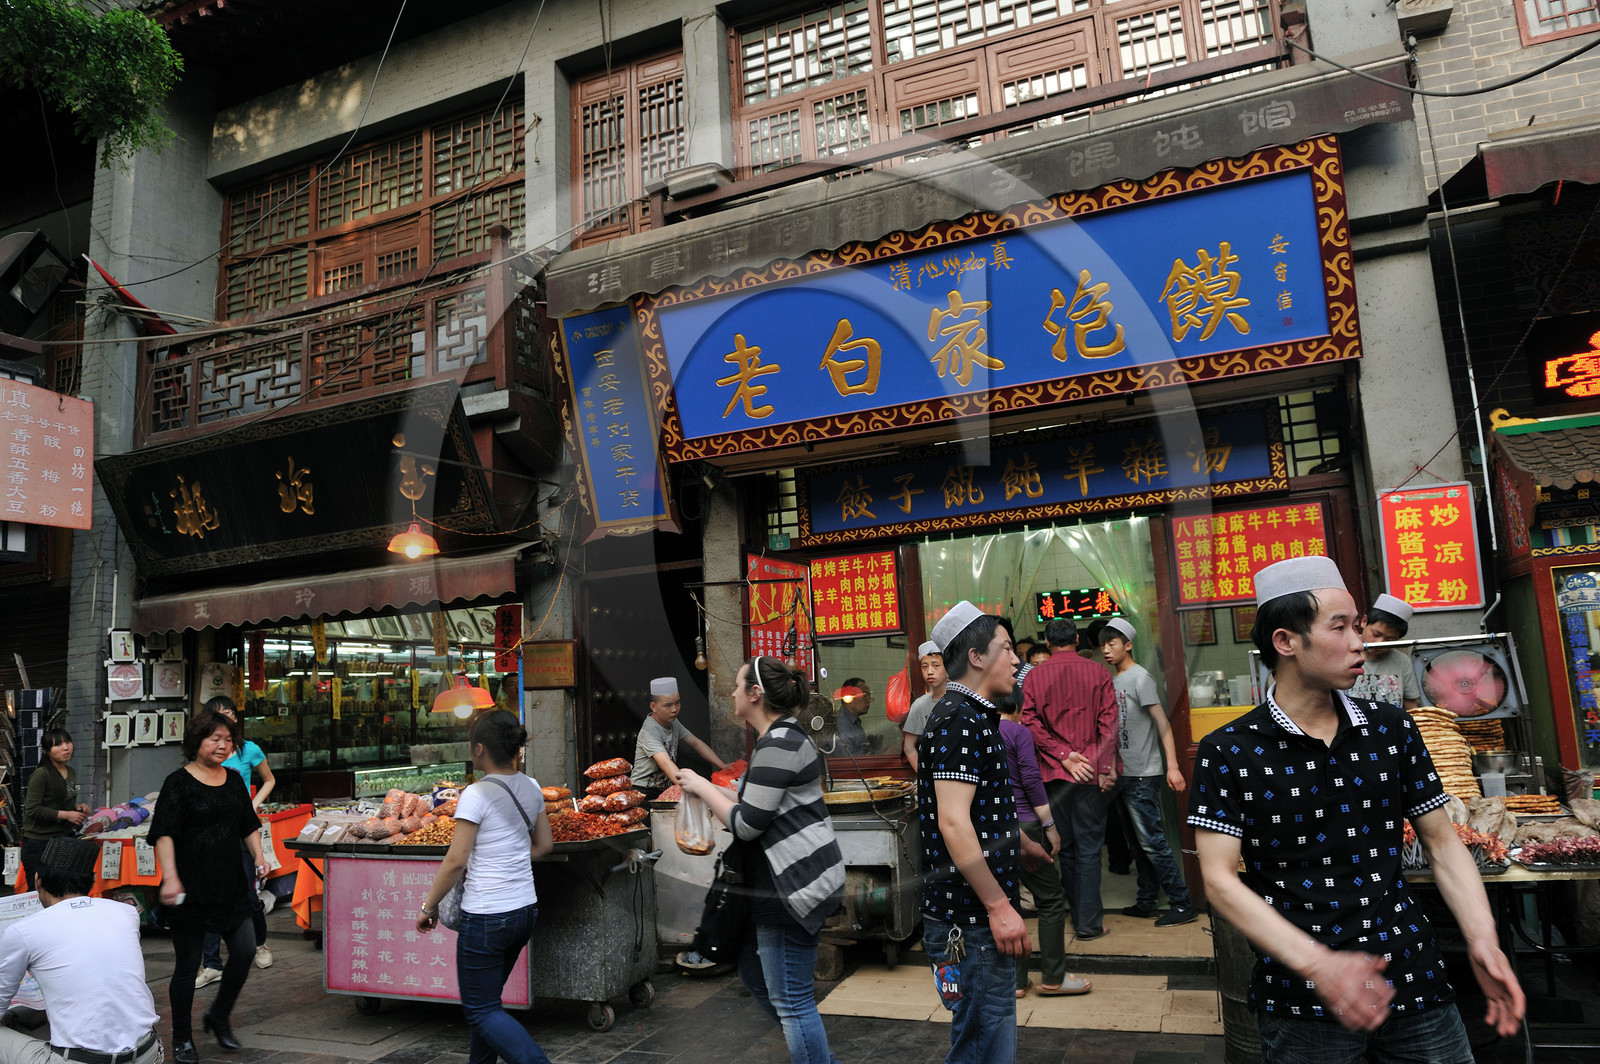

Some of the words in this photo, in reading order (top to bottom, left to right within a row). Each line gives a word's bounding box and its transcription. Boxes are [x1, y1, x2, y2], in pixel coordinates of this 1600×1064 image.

[890, 260, 912, 291] 清
[990, 239, 1014, 270] 真
[1, 410, 80, 436] 老字号干货
[7, 389, 31, 409] 真
[593, 347, 641, 508] 西安老刘家干货
[5, 428, 32, 514] 香酥五香大豆
[38, 434, 62, 518] 酸梅粉
[70, 446, 85, 517] 回坊一绝
[1176, 520, 1198, 600] 八宝稀饭
[1193, 518, 1217, 598] 麻辣米线
[1211, 515, 1235, 596] 酸汤水饺
[1229, 513, 1253, 595] 麻酱凉皮
[1247, 511, 1267, 562] 牛肉
[1266, 509, 1285, 560] 牛肉
[1429, 503, 1469, 602] 炒凉粉
[811, 562, 827, 633] 烤羊腰
[824, 560, 840, 632] 烤羊肉
[838, 558, 855, 630] 羊肉泡馍
[852, 557, 869, 630] 牛肉泡馍
[866, 555, 883, 628] 小炒泡馍
[880, 553, 897, 627] 手抓羊肉
[1040, 591, 1118, 618] 请上二楼
[351, 907, 368, 984] 香酥芝麻辣椒
[376, 908, 394, 985] 麻辣花生
[402, 909, 421, 987] 五香花生
[429, 932, 448, 989] 香大豆
